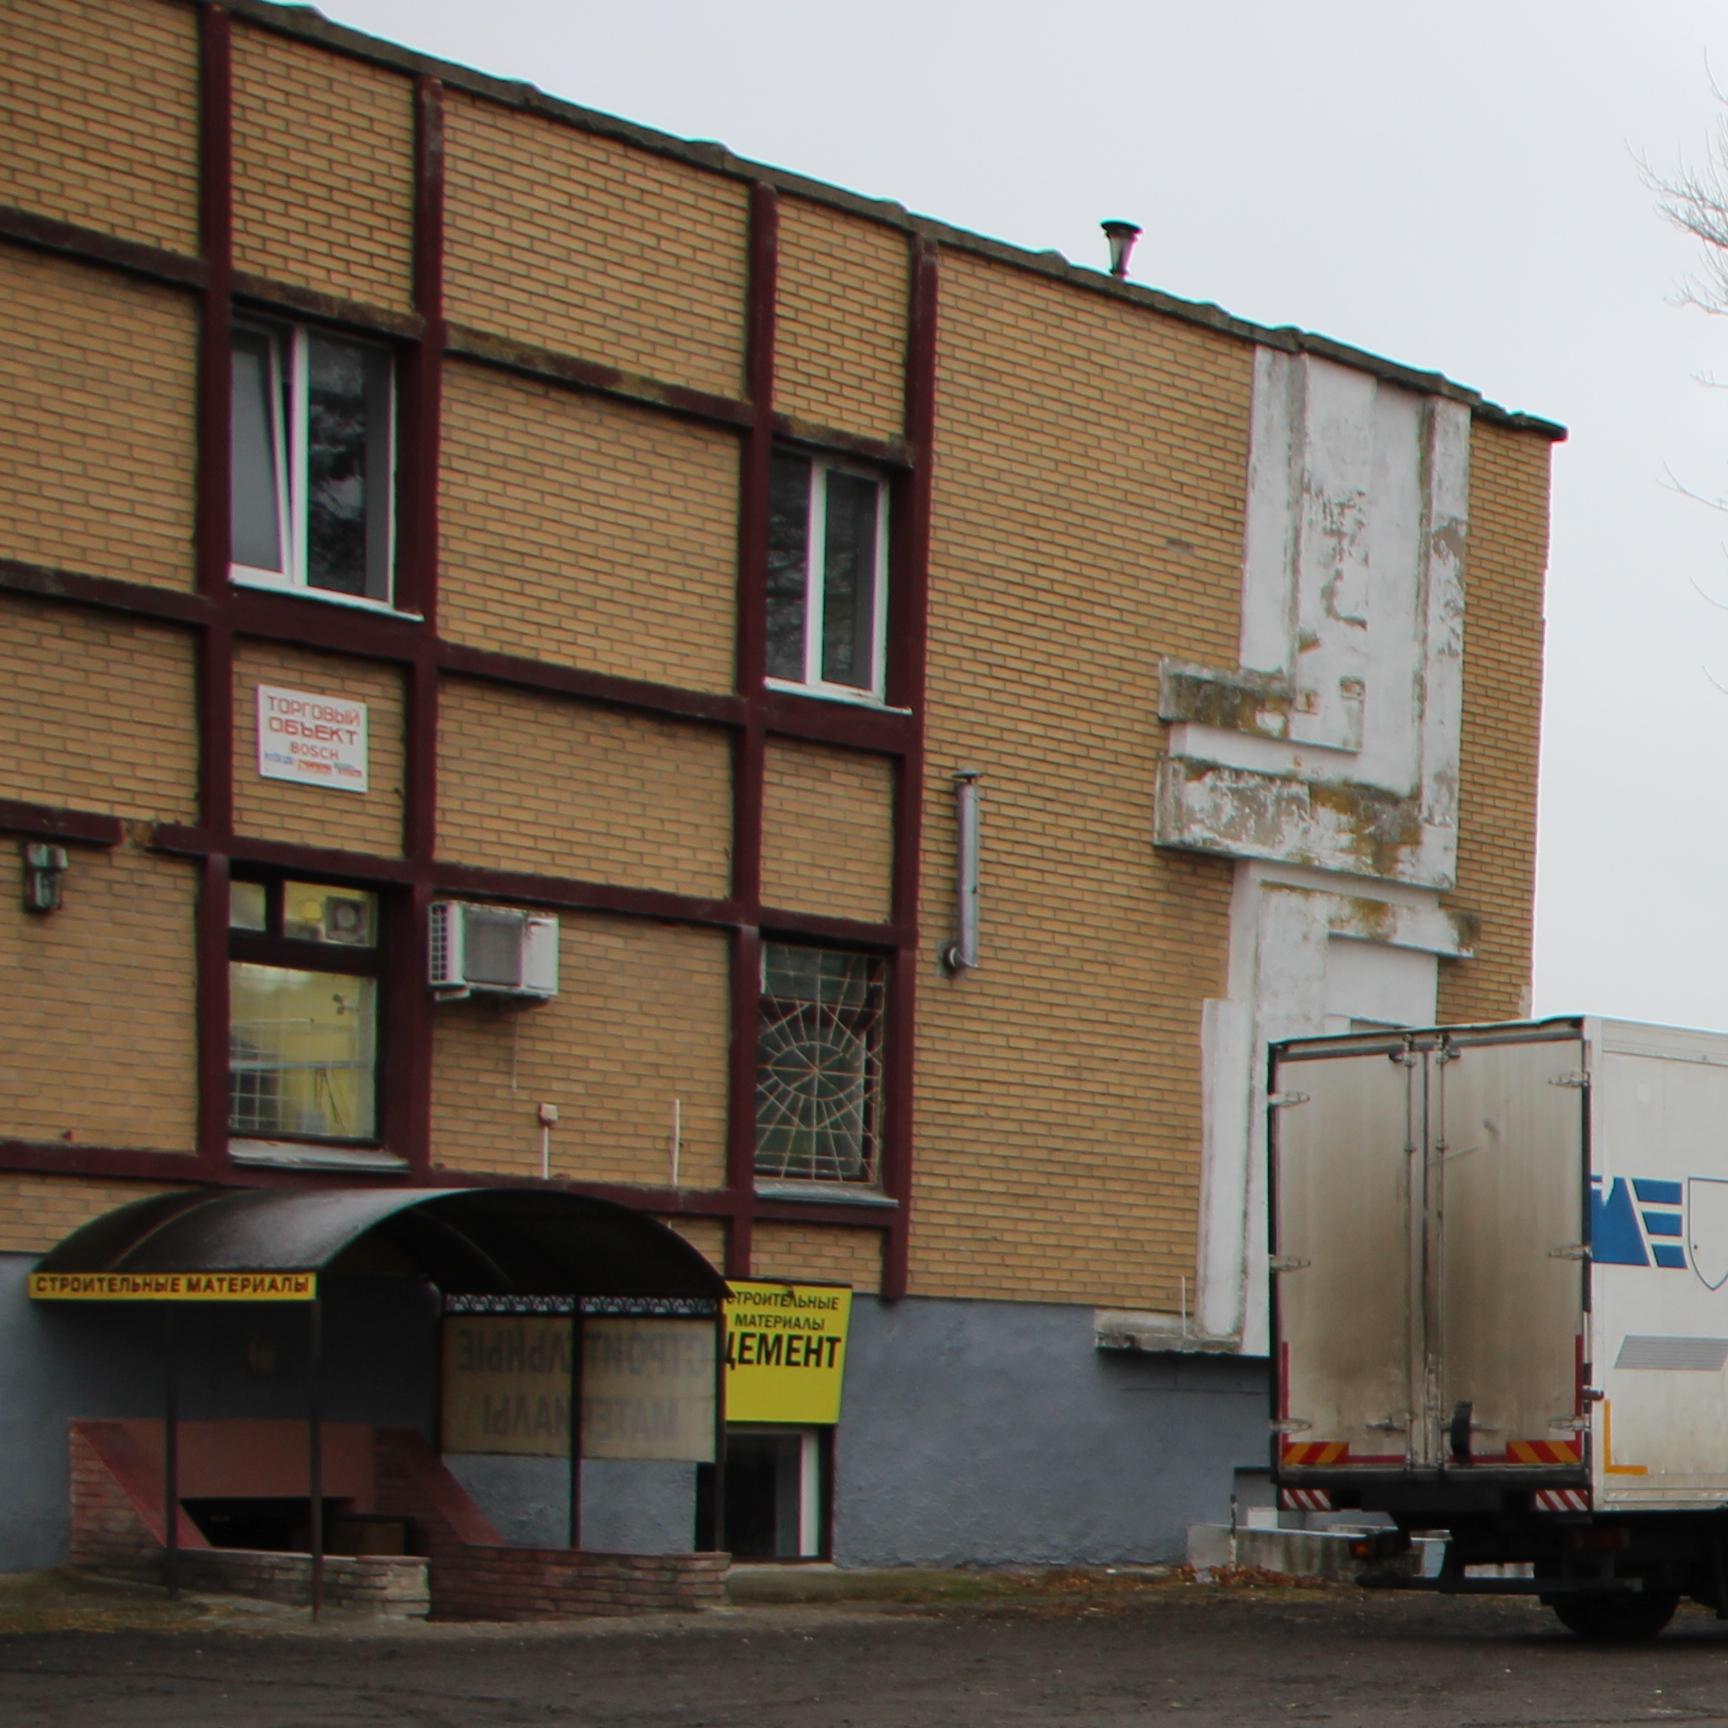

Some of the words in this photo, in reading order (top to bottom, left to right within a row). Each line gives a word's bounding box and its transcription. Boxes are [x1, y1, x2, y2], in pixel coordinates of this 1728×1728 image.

[267, 695, 361, 726] ТОРГОВЫЙ
[268, 716, 358, 745] ОБЪЕКТ
[290, 741, 339, 760] BOSCH
[36, 1275, 181, 1293] СТРОИТЕЛЬНЫЕ
[186, 1275, 309, 1293] МАТЕРИАЛЫ
[734, 1313, 826, 1331] МАТЕРИАЛЫ
